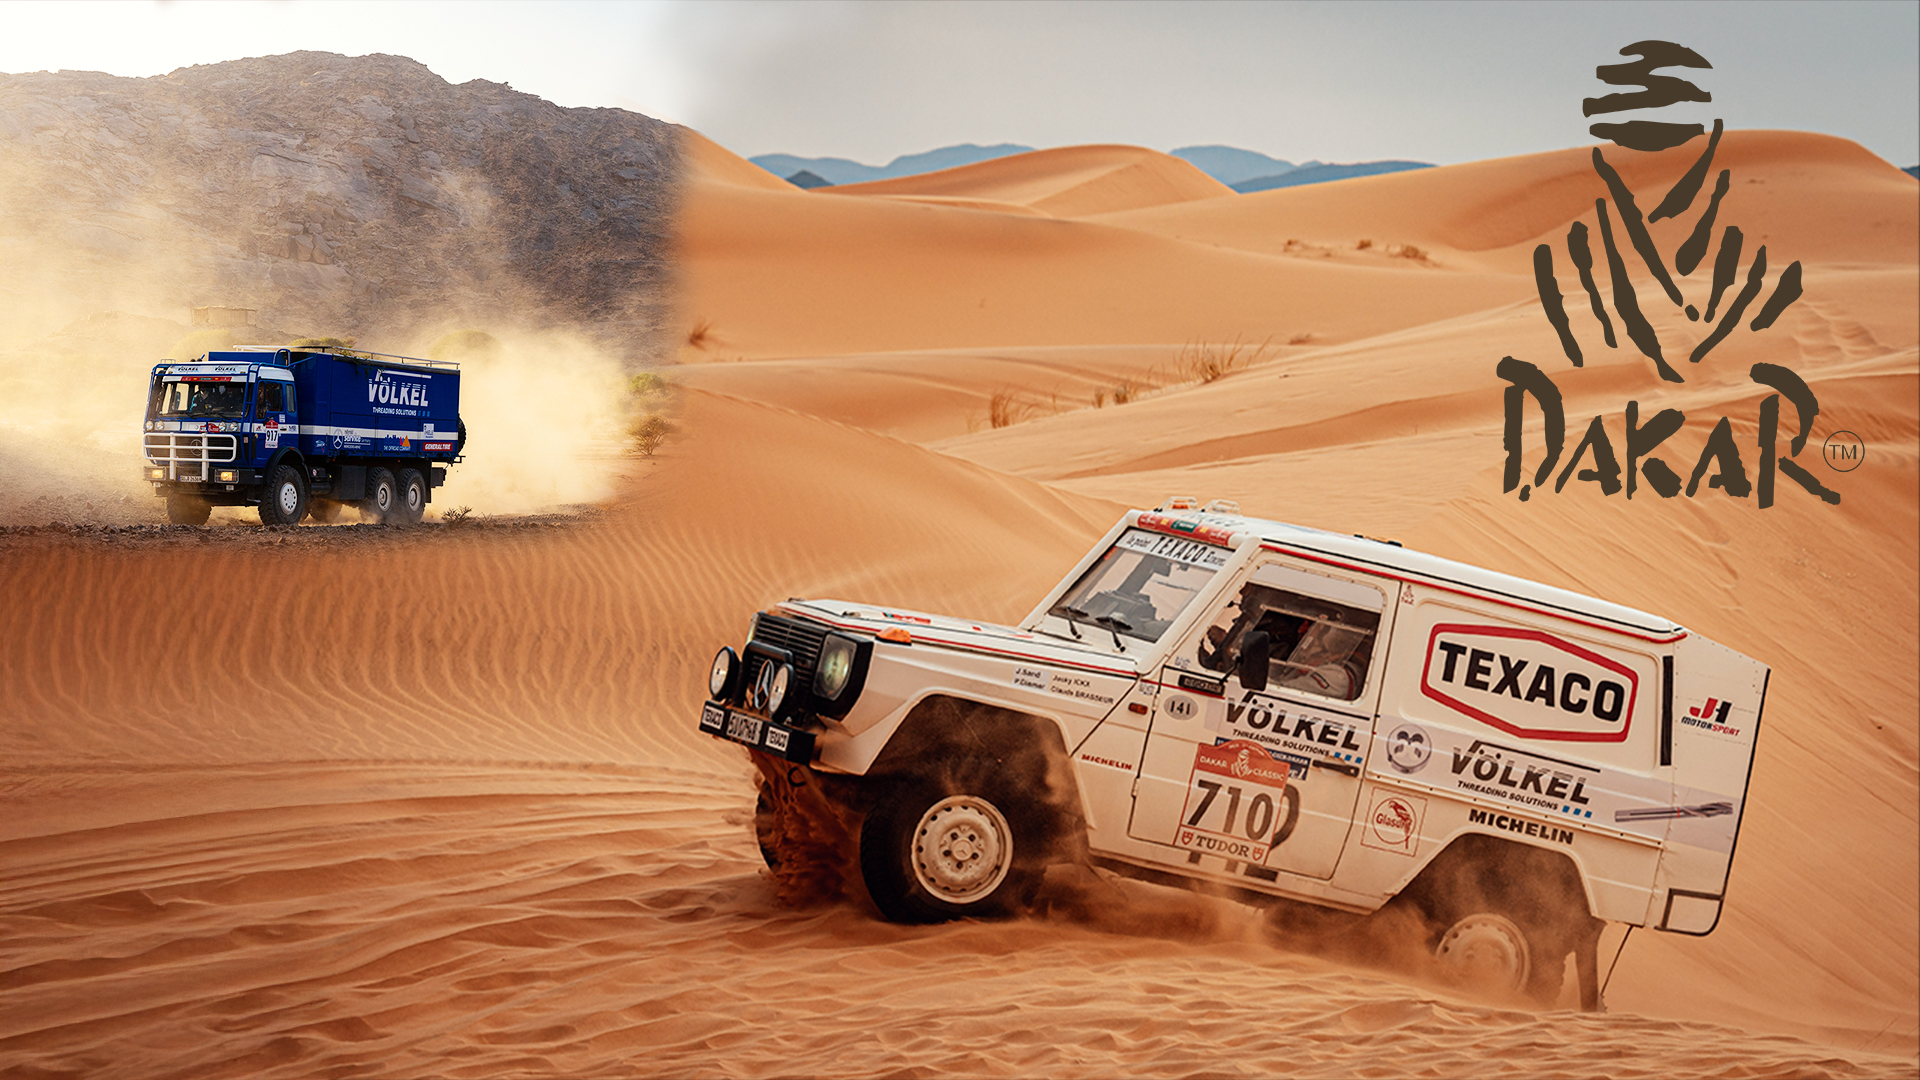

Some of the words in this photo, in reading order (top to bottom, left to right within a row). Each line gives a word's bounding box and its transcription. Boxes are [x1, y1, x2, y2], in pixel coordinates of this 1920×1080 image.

[368, 376, 429, 407] VÖLKEL
[372, 407, 395, 415] THREADING
[395, 408, 417, 416] SOLUTIONS
[266, 430, 278, 441] 917
[1150, 536, 1208, 563] TEXACO
[1439, 641, 1625, 722] TEXACO
[1170, 700, 1191, 715] 141
[1226, 697, 1361, 751] VÖLKEL
[1233, 729, 1281, 746] THREADING
[1283, 740, 1330, 757] SOLUTIONS
[1081, 754, 1133, 770] MICHELIN
[1200, 756, 1228, 768] DAKAR
[1252, 766, 1285, 781] CLASSIC
[1451, 746, 1590, 805] VÖLKEL
[1457, 780, 1508, 798] THREADING
[1509, 792, 1559, 811] SOLUTIONS
[1187, 779, 1273, 841] 710
[1469, 808, 1574, 845] MICHELIN
[1196, 835, 1250, 857] TUDOR
